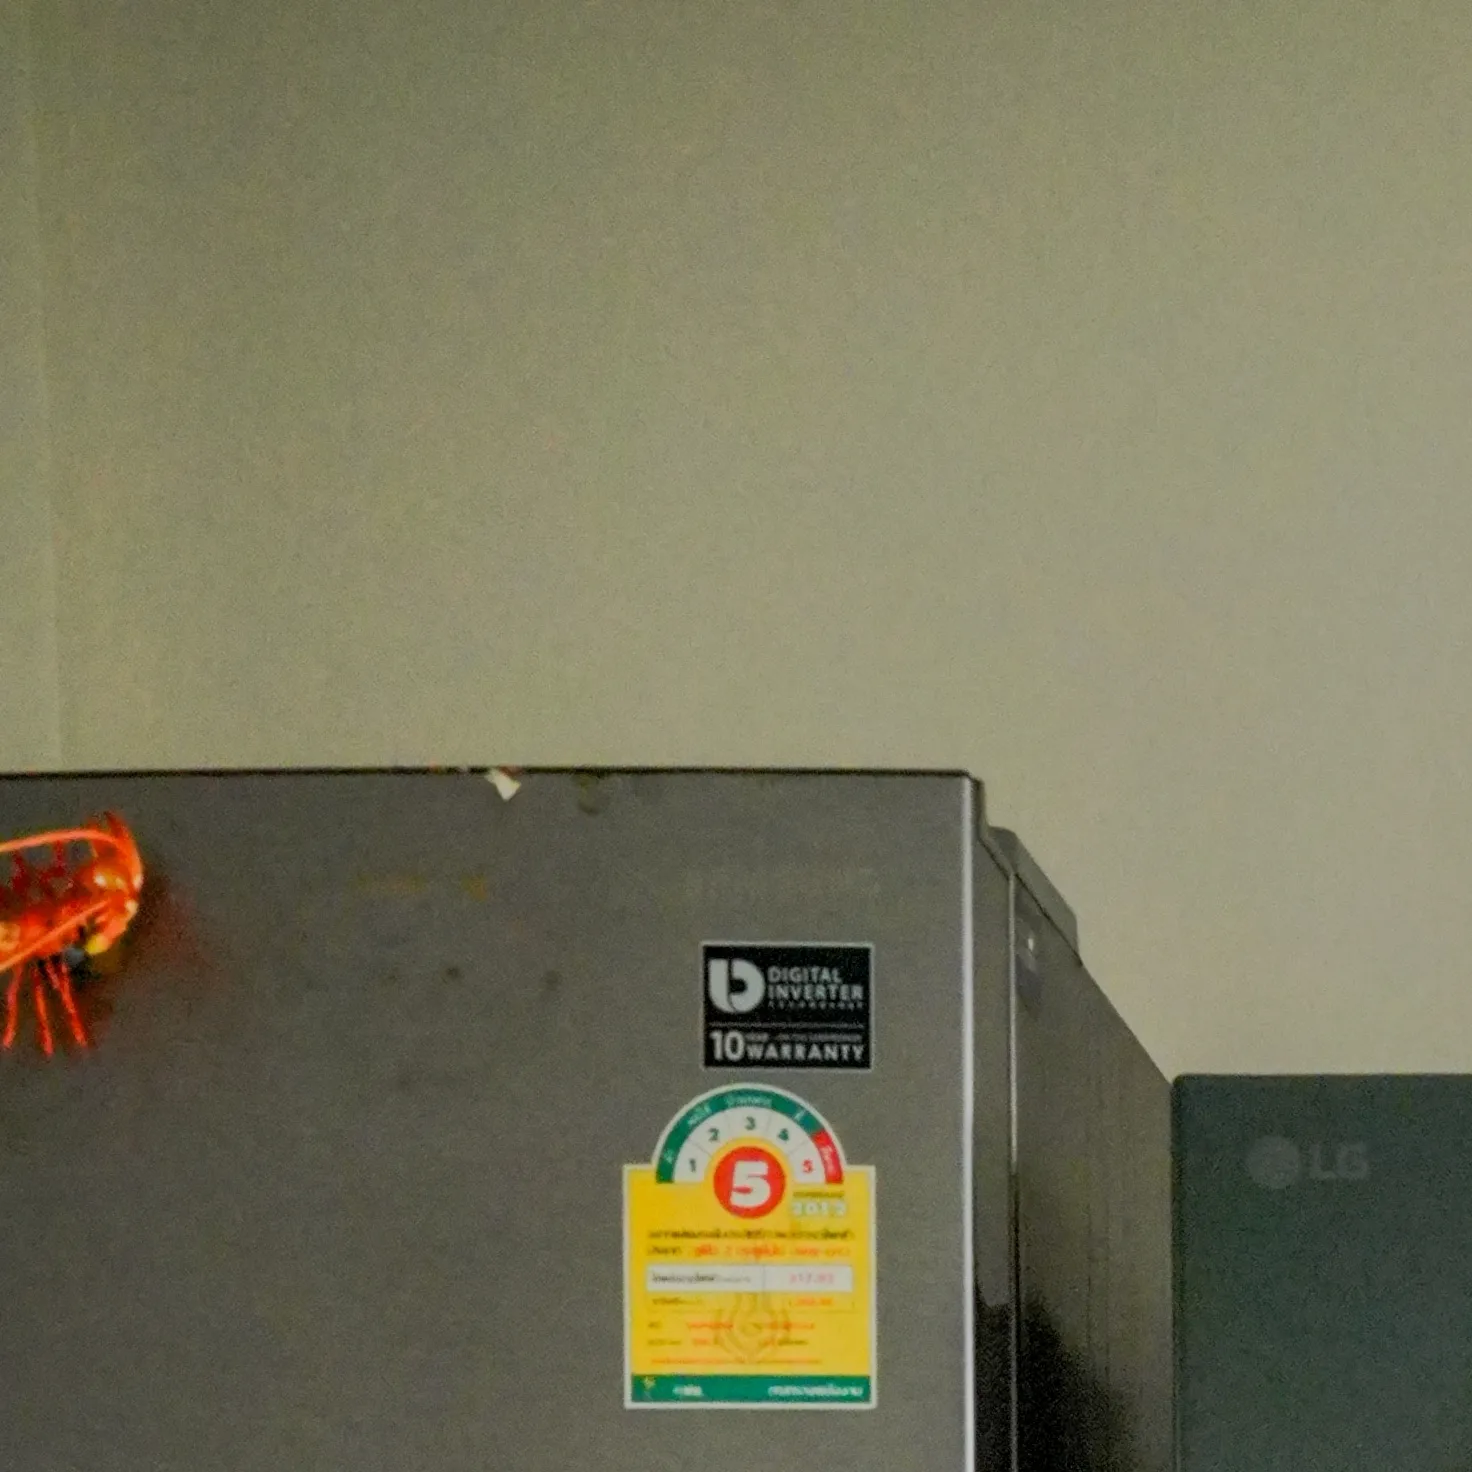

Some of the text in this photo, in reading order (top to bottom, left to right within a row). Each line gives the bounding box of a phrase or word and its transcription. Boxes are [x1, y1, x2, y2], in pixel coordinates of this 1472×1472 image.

[767, 966, 842, 984] DIGITAL
[767, 984, 864, 1001] INVERTER
[709, 1030, 745, 1062] 10
[747, 1043, 865, 1061] WARRANTY
[688, 1158, 697, 1173] 1
[707, 1127, 720, 1142] 2
[744, 1116, 756, 1131] 3
[777, 1127, 790, 1142] 4
[802, 1159, 814, 1173] 5
[1308, 1141, 1370, 1181] LG
[729, 1159, 772, 1208] 5
